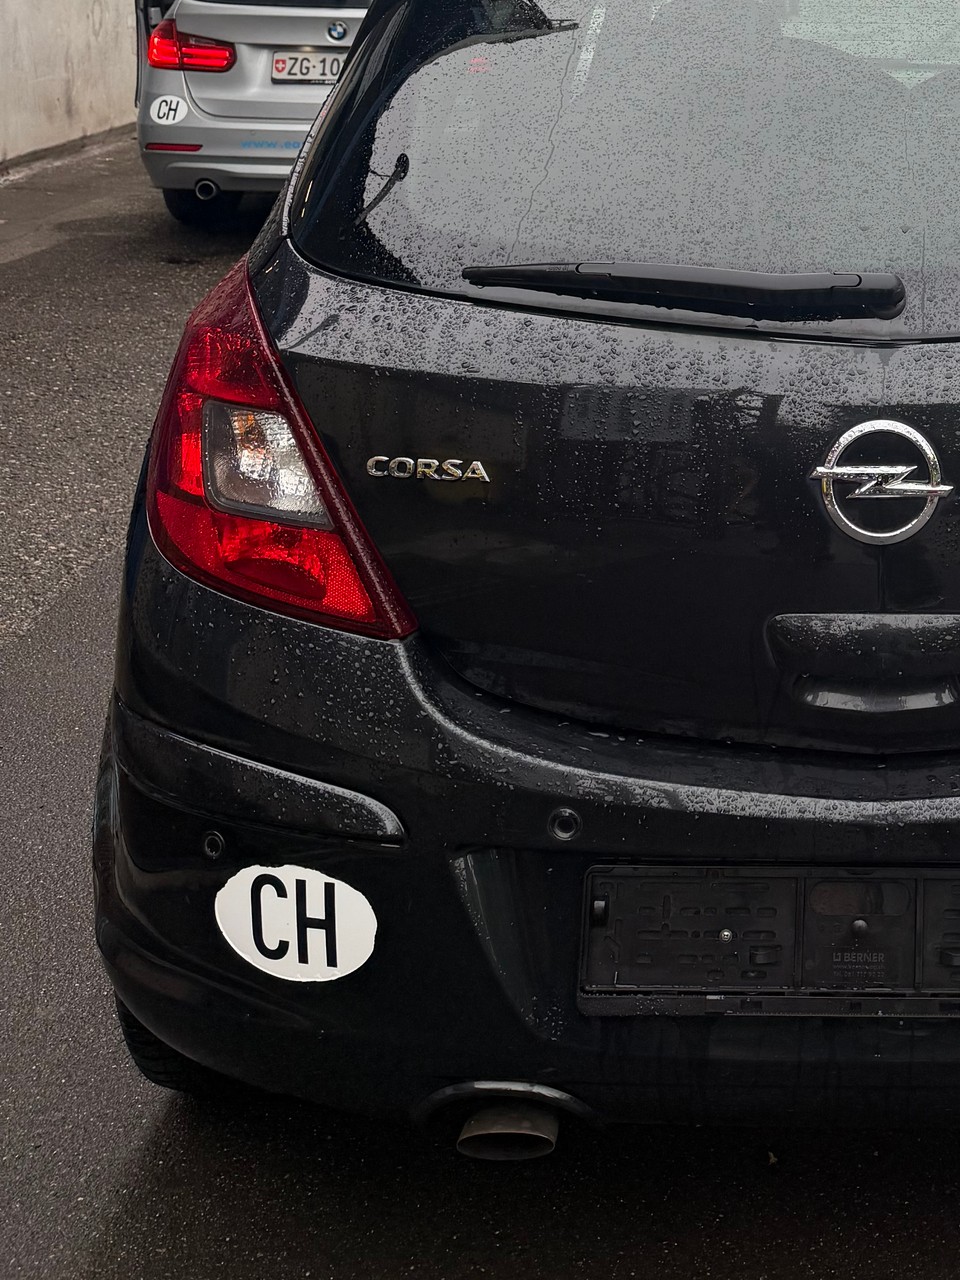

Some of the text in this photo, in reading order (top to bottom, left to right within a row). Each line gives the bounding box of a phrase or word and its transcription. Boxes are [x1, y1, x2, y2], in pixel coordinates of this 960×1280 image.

[157, 99, 180, 121] CH
[366, 455, 491, 483] CORSA
[250, 873, 338, 968] CH
[843, 952, 885, 963] BERNER
